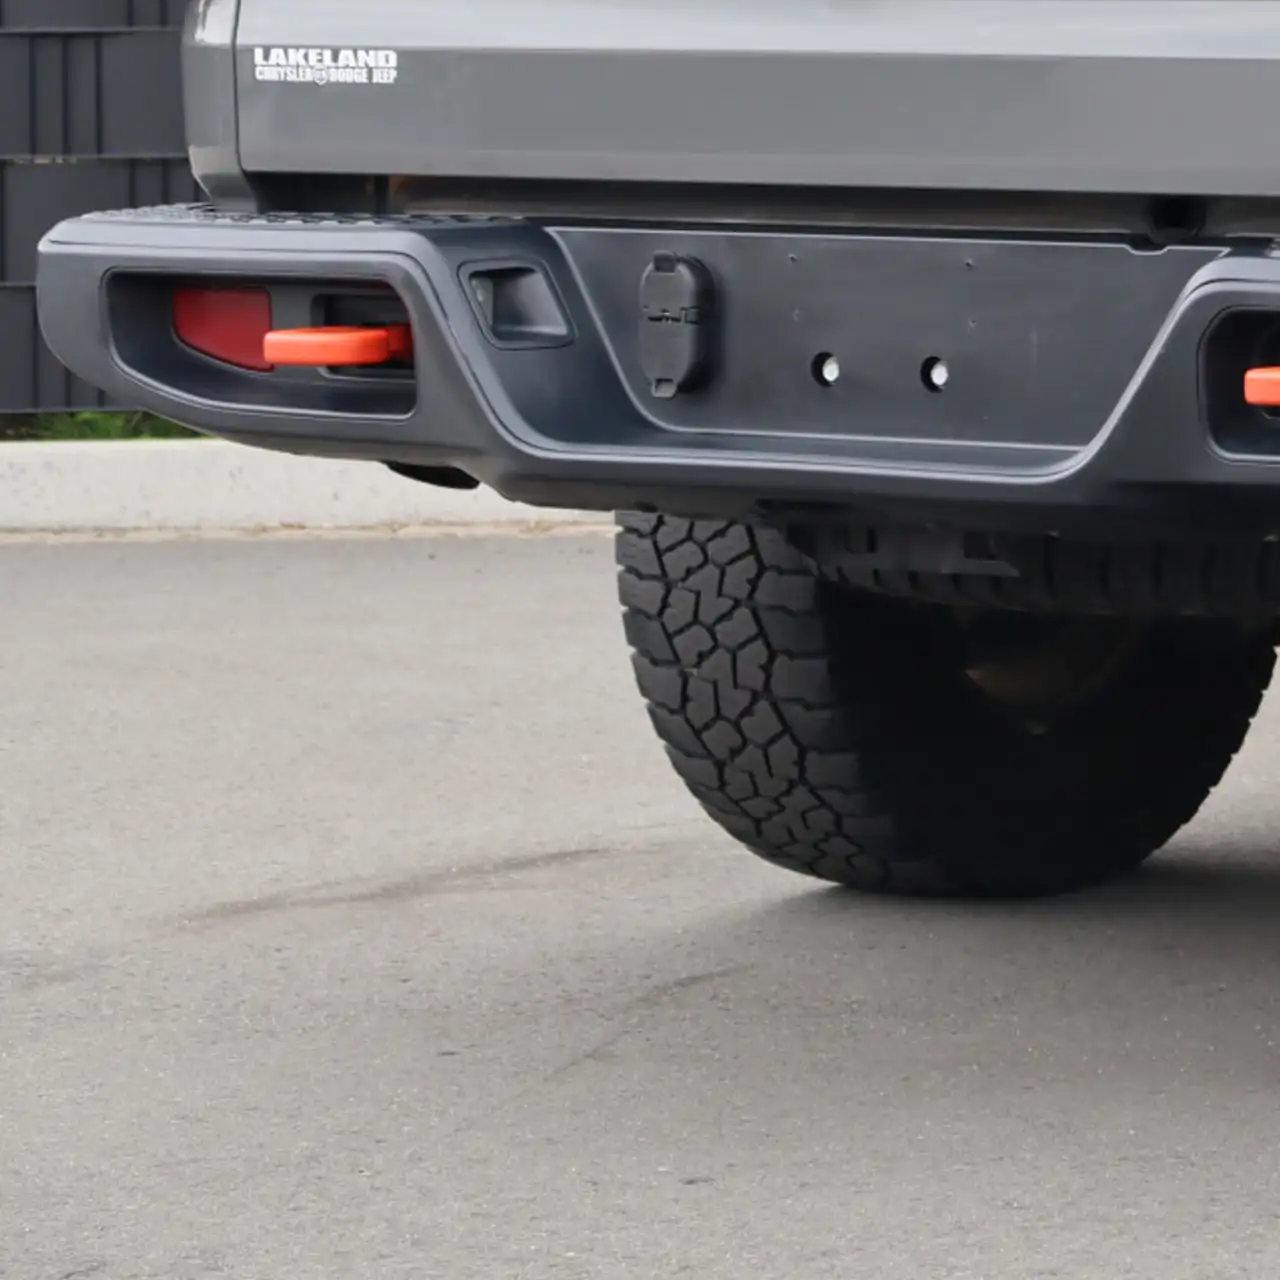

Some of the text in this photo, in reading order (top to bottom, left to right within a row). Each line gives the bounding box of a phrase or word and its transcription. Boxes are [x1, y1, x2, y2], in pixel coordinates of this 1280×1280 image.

[254, 47, 398, 68] LAKELAND
[255, 66, 398, 84] CHRYSLER DODGE JEEP
